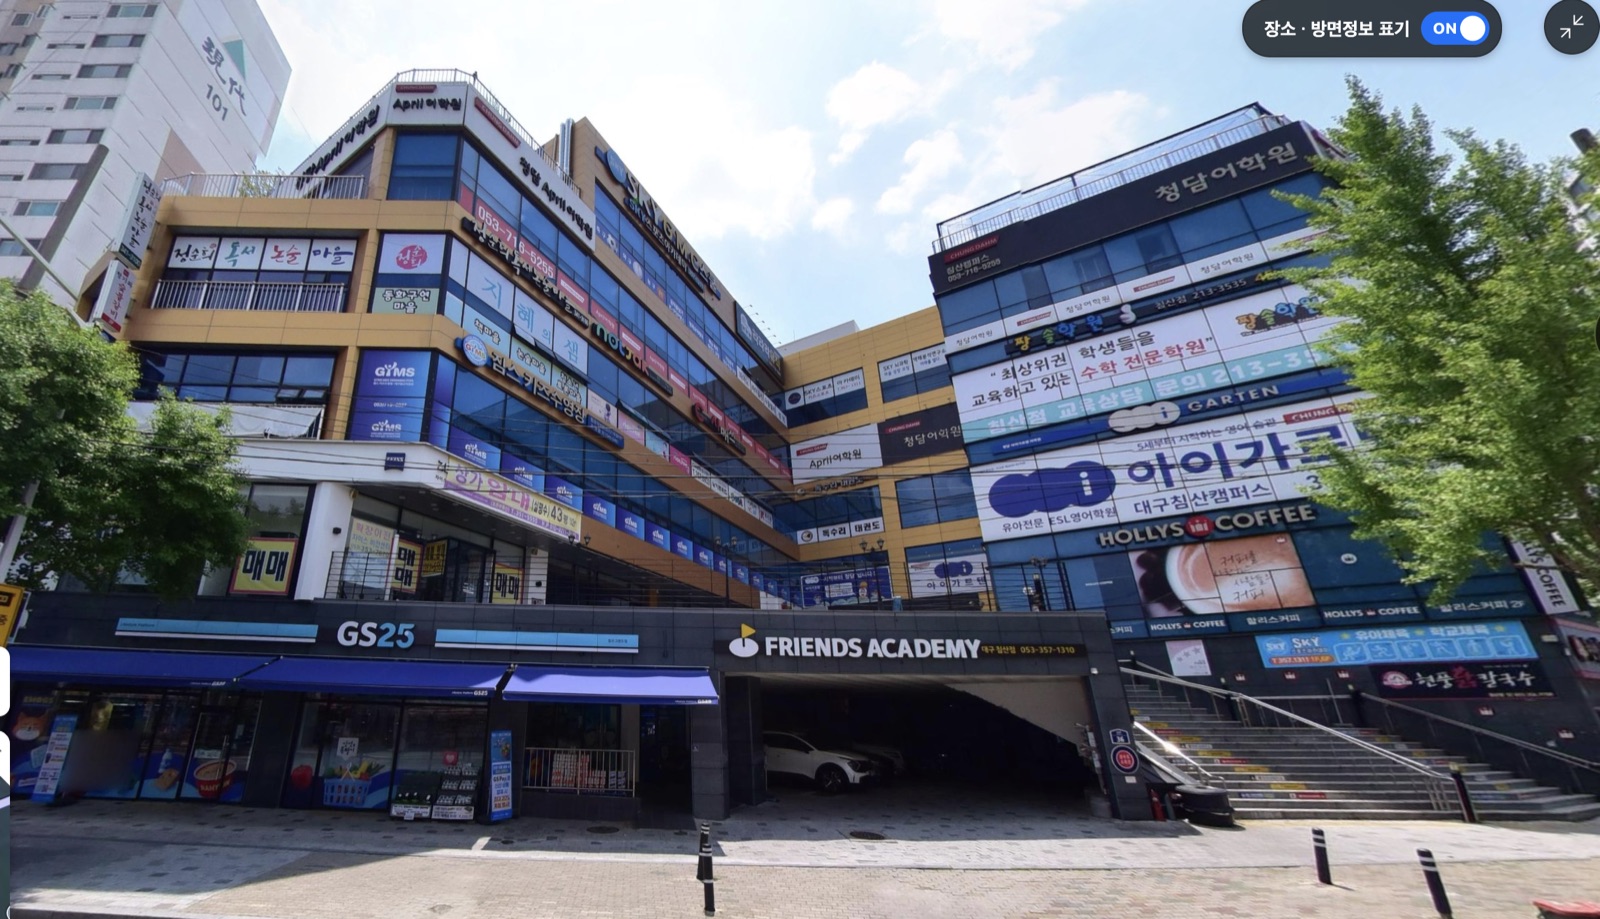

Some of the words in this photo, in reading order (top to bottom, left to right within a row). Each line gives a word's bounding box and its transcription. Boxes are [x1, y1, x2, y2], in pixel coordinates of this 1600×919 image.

[205, 84, 229, 121] 101
[1155, 141, 1298, 202] 청담어학원
[225, 241, 256, 267] 독서
[271, 244, 301, 265] 논술
[313, 246, 354, 265] 마을
[950, 244, 974, 261] CHUNG
[974, 237, 998, 251] DAHM
[1200, 252, 1254, 275] 청담어학원
[383, 289, 431, 302] 동화구연
[1192, 278, 1247, 300] 213-3535
[393, 301, 417, 314] 마을
[1078, 331, 1156, 359] 학생들을
[374, 362, 416, 378] GYMS
[972, 381, 1037, 408] 교육하고
[1041, 372, 1072, 393] 있는
[1081, 361, 1118, 381] 수학
[1058, 386, 1145, 420] 교육상담
[1155, 371, 1206, 397] 문의
[1188, 385, 1280, 411] GARTEN
[371, 419, 402, 432] GYMS
[1291, 407, 1336, 422] CHUNG
[903, 425, 962, 448] 청담어학원
[488, 478, 532, 512] 임대
[1134, 483, 1272, 515] 대구침산캠퍼스
[854, 520, 881, 533] 태권도
[1002, 518, 1045, 533] 유아전문
[1050, 506, 1118, 526] ESL영어학원
[1099, 521, 1185, 547] HOLLYS
[1214, 504, 1317, 531] COFFEE
[241, 549, 290, 582] 매매
[495, 572, 520, 600] 매매
[1536, 567, 1567, 607] COFFEE
[1246, 613, 1301, 626] 할리스커피
[1324, 608, 1364, 619] HOLLYS
[1378, 605, 1421, 616] COFFEE
[336, 620, 416, 649] GS25
[1150, 621, 1182, 632] HOLLYS
[1192, 618, 1226, 629] COFFEE
[1355, 628, 1411, 641] 유아체육
[765, 636, 863, 659] FRIENDS
[866, 637, 981, 660] ACADEMY
[981, 645, 996, 655] 대구
[1020, 645, 1075, 655] 053-357-1310
[1291, 636, 1320, 649] SKY
